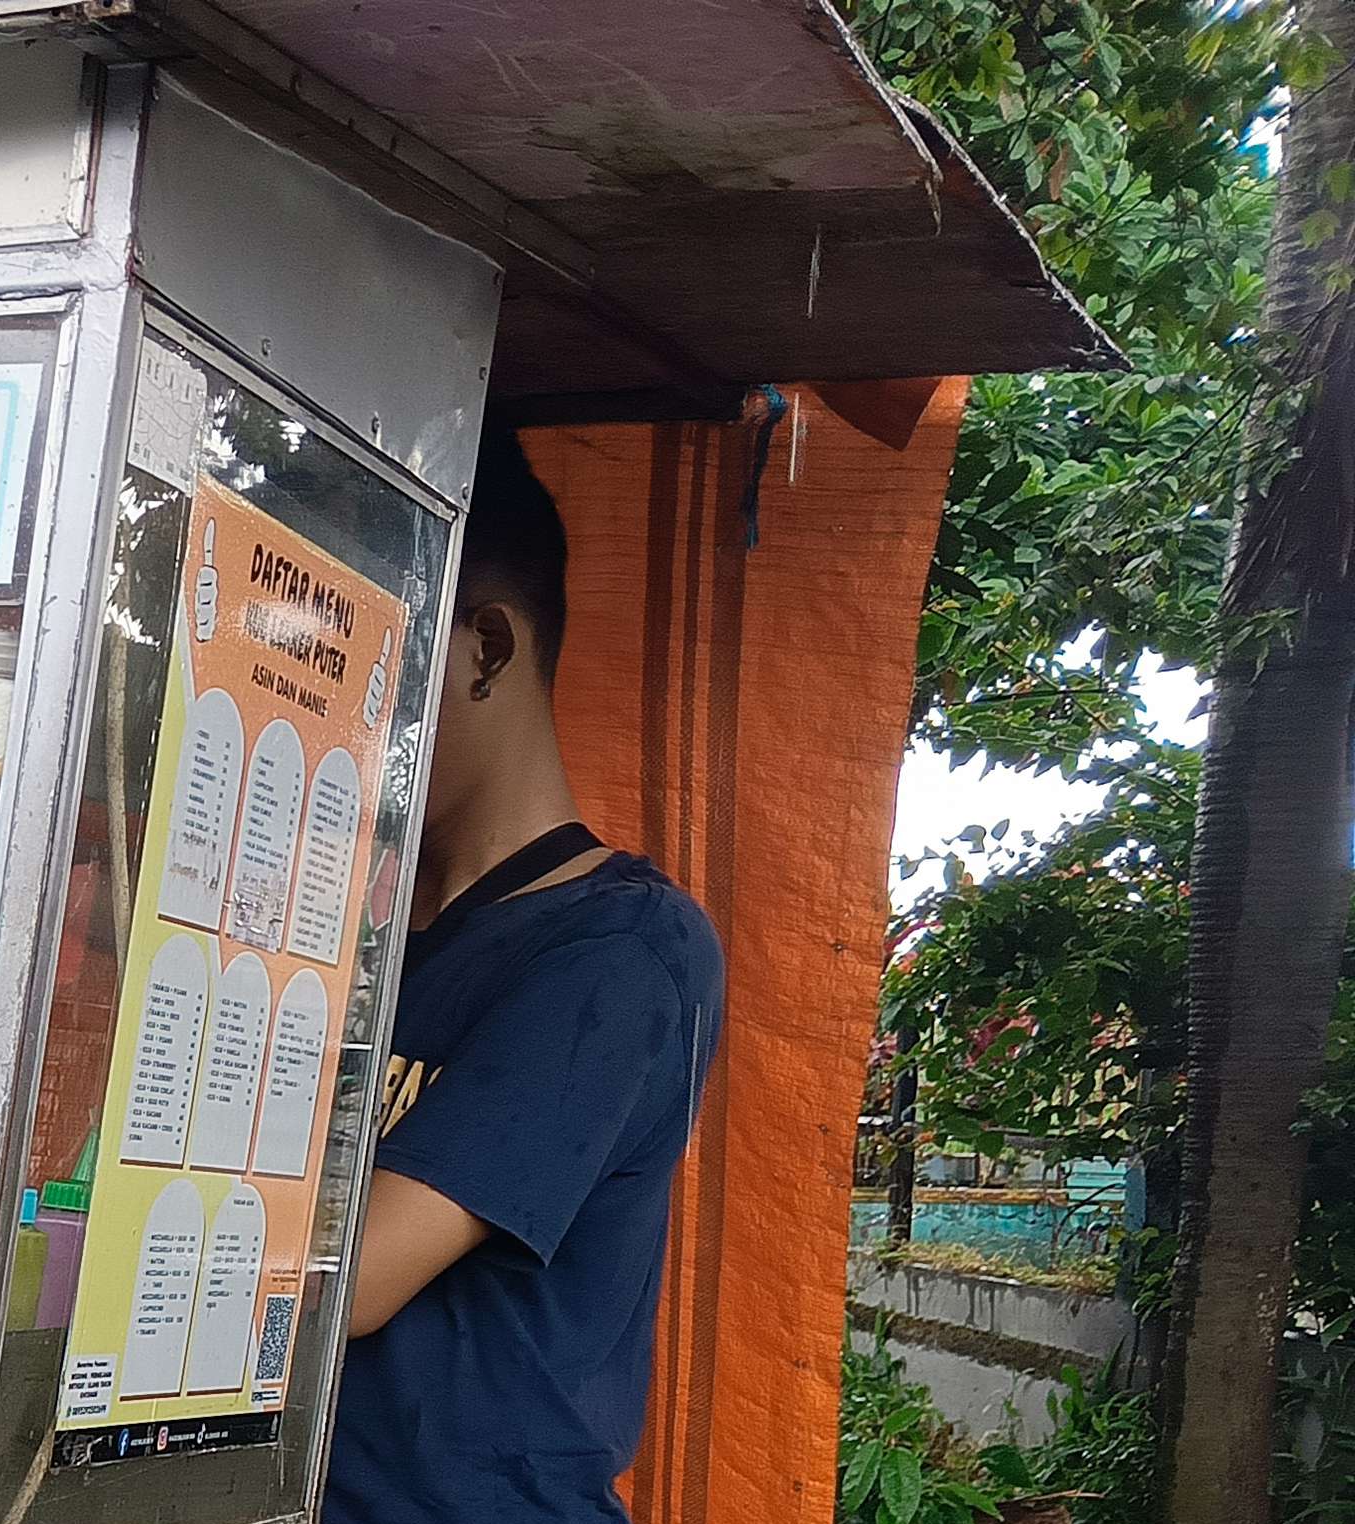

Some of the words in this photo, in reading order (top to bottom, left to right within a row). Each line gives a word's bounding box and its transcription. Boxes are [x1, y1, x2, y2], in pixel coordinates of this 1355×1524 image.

[250, 543, 310, 608] DAFTAR
[311, 578, 355, 639] MENU
[251, 663, 276, 692] ASIN
[276, 675, 298, 703] DAN
[312, 640, 347, 685] PUTER
